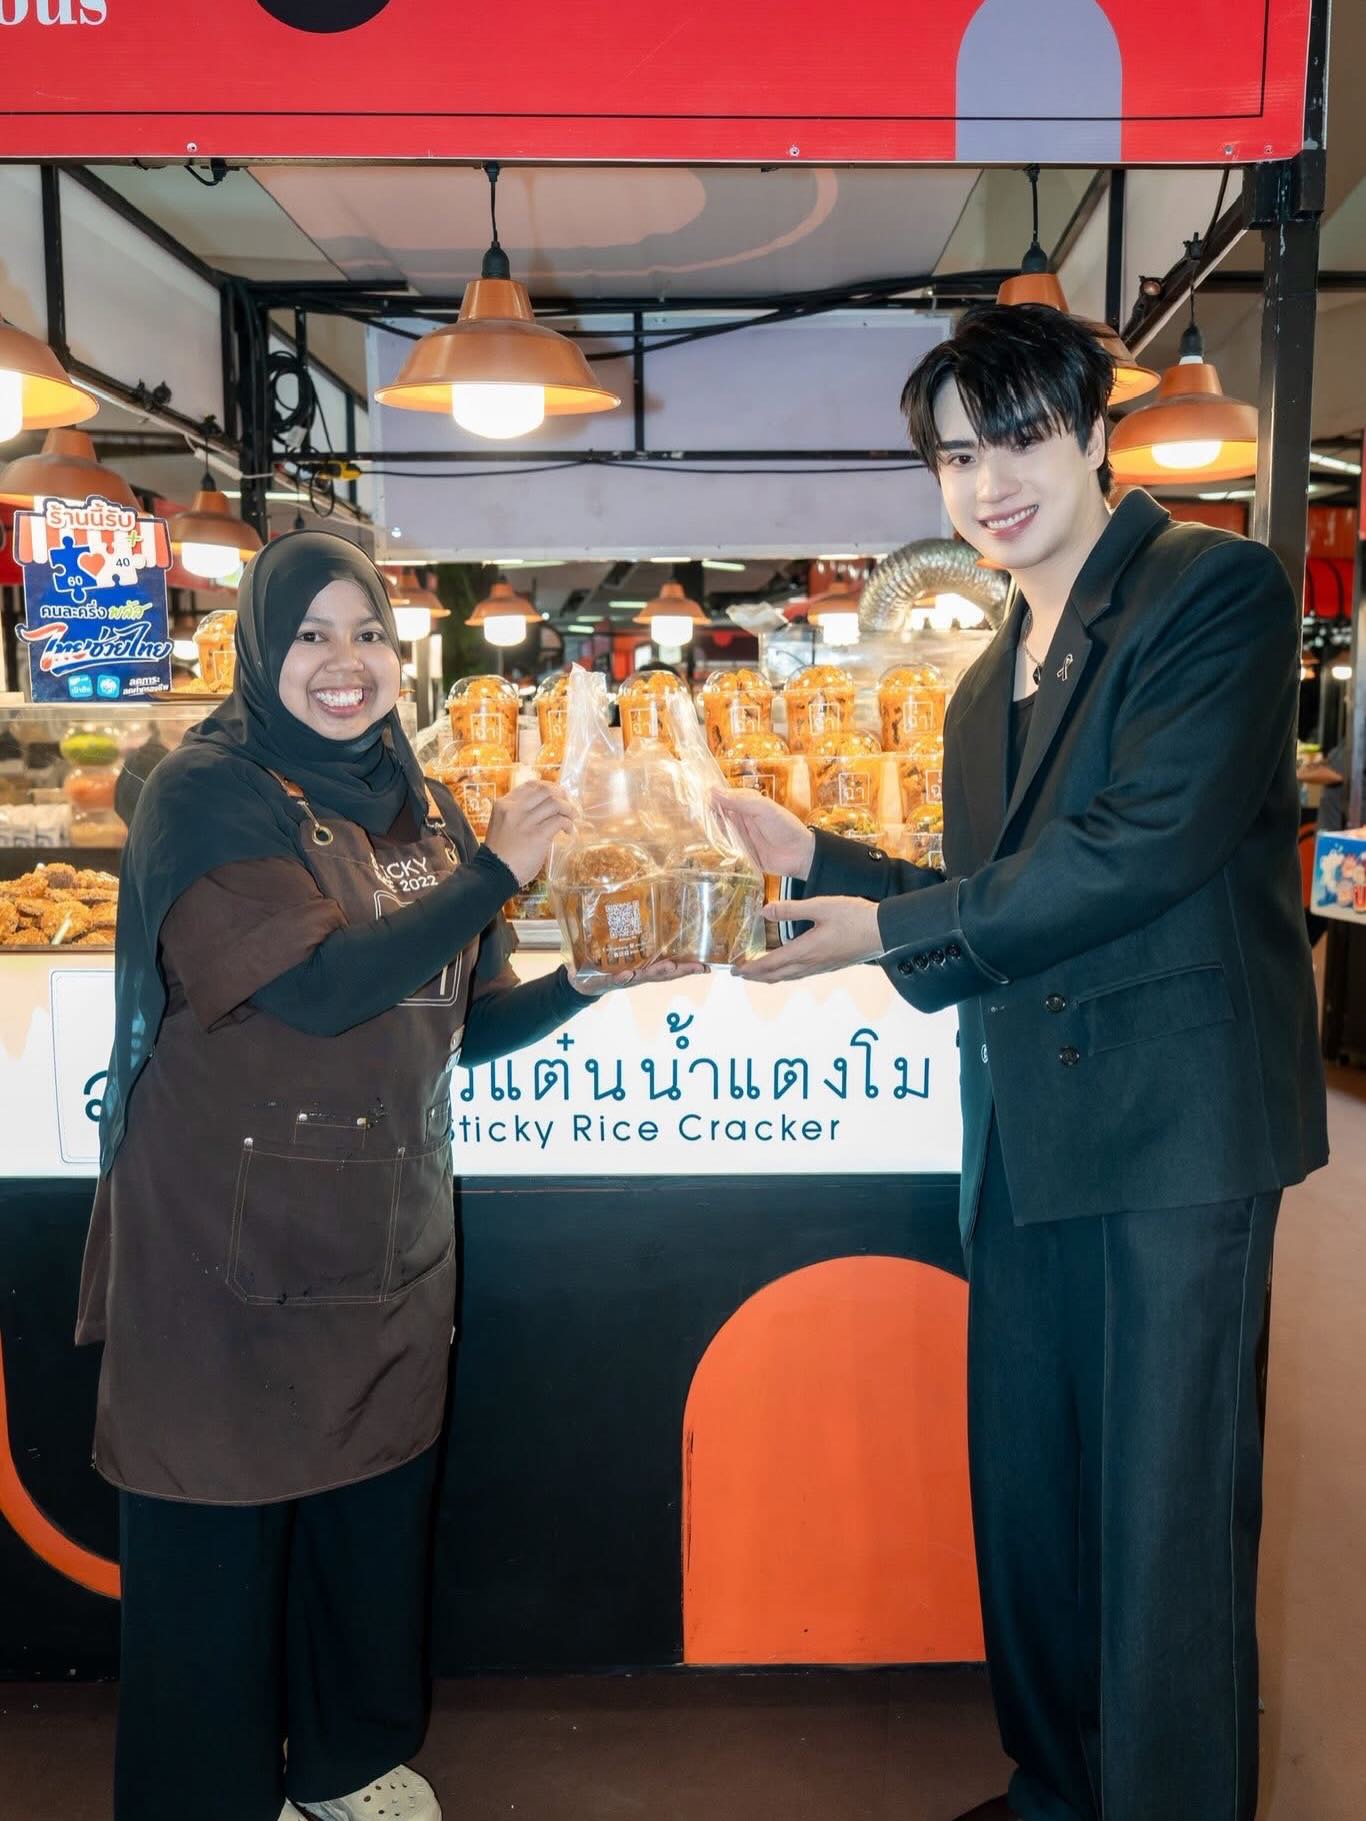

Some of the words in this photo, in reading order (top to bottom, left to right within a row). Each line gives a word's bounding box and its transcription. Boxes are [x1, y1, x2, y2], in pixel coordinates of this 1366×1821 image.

[50, 503, 132, 527] ร้านนี้รับ
[115, 556, 131, 567] 40
[67, 575, 84, 587] 60
[400, 875, 439, 892] 2022
[573, 1114, 658, 1142] Rice
[679, 1114, 840, 1142] Cracker
